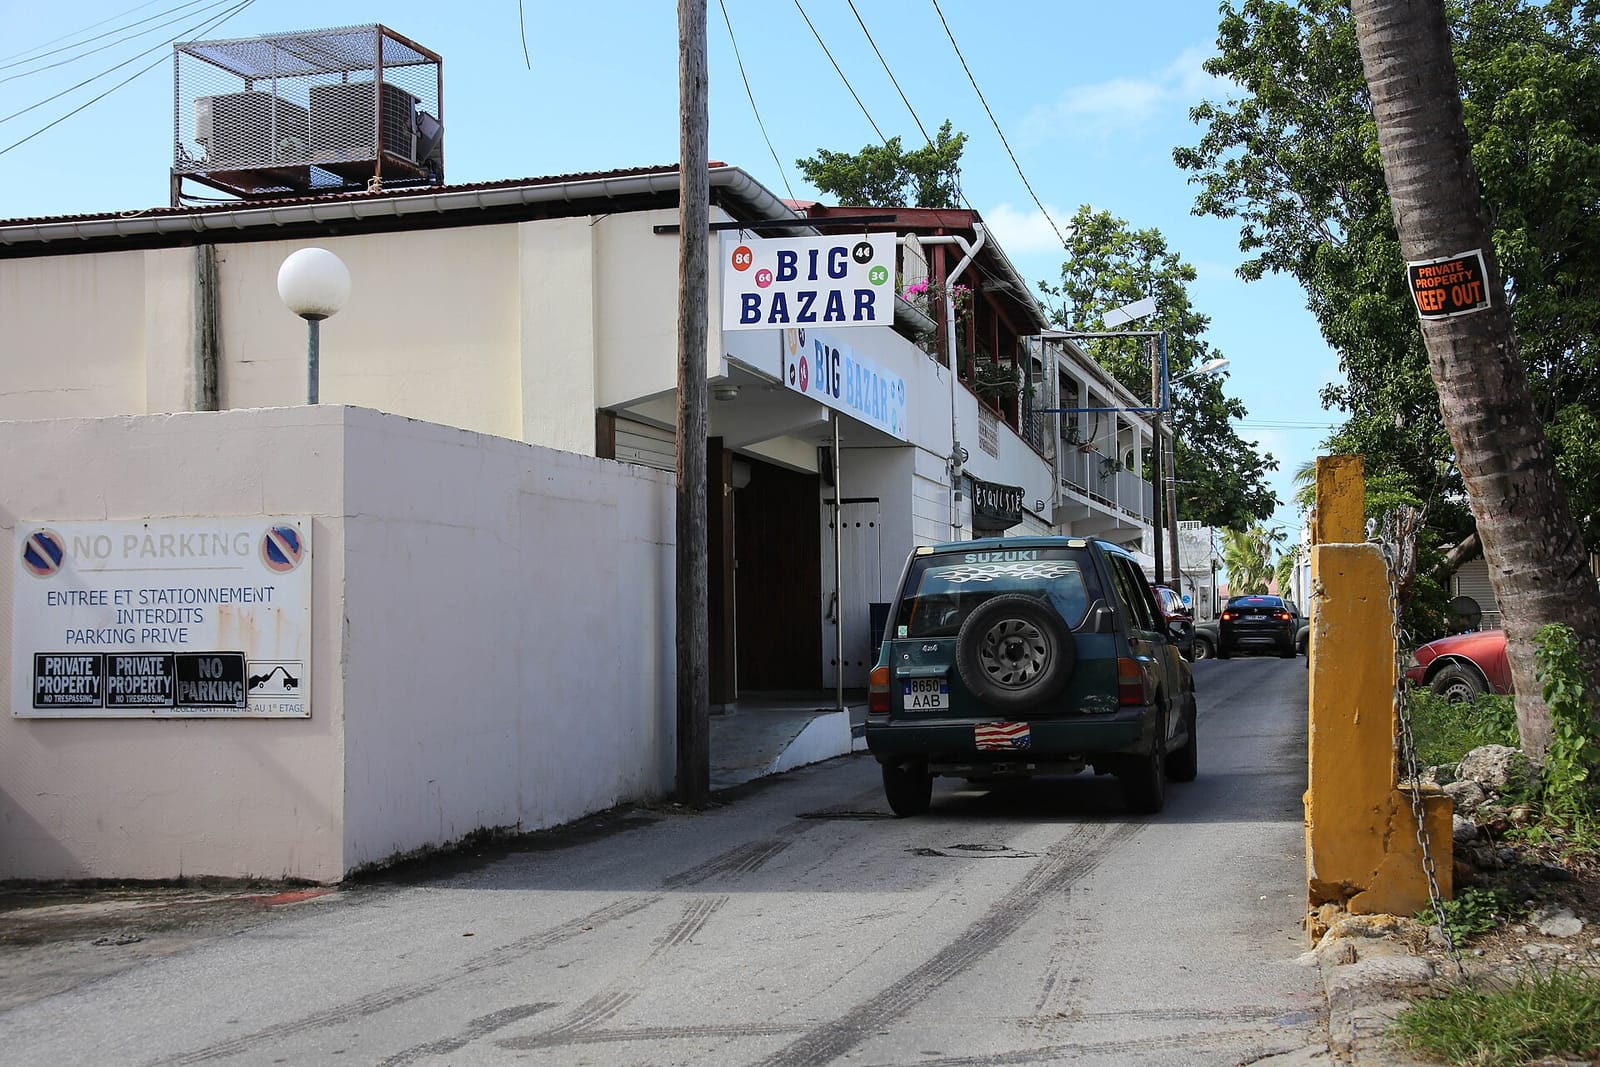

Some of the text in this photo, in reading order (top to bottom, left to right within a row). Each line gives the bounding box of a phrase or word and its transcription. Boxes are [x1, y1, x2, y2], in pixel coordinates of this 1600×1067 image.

[735, 253, 750, 264] 8€
[855, 247, 870, 258] 4€
[776, 247, 848, 281] BIG
[1418, 261, 1464, 278] PRIVATE
[758, 273, 771, 283] 6€
[871, 271, 885, 281] 3€
[1415, 270, 1473, 289] PROPERTY
[1416, 281, 1480, 311] KEEP OUT
[740, 289, 876, 324] BAZAR
[815, 339, 840, 399] BIG
[846, 356, 888, 424] BAZAR
[73, 532, 250, 559] NO PARKING
[965, 550, 1037, 564] SUZUKI
[47, 586, 274, 606] ENTREE ET STATIONNEMENT
[117, 608, 203, 625] INTERDITS
[66, 627, 188, 645] PARKING PRIVE
[45, 657, 94, 675] PRIVATE
[116, 657, 164, 675] PRIVATE
[198, 658, 223, 678] NO
[37, 676, 100, 694] PROPERTY
[108, 676, 171, 694] PROPERTY
[180, 680, 243, 702] PARKING
[912, 680, 939, 693] 8650
[44, 695, 53, 703] NO
[54, 694, 93, 703] TRESPASSING
[115, 695, 124, 703] NO
[126, 694, 165, 703] TRESPASSING
[912, 694, 941, 708] AAB
[254, 704, 266, 713] AU
[280, 703, 305, 713] ETAGE
